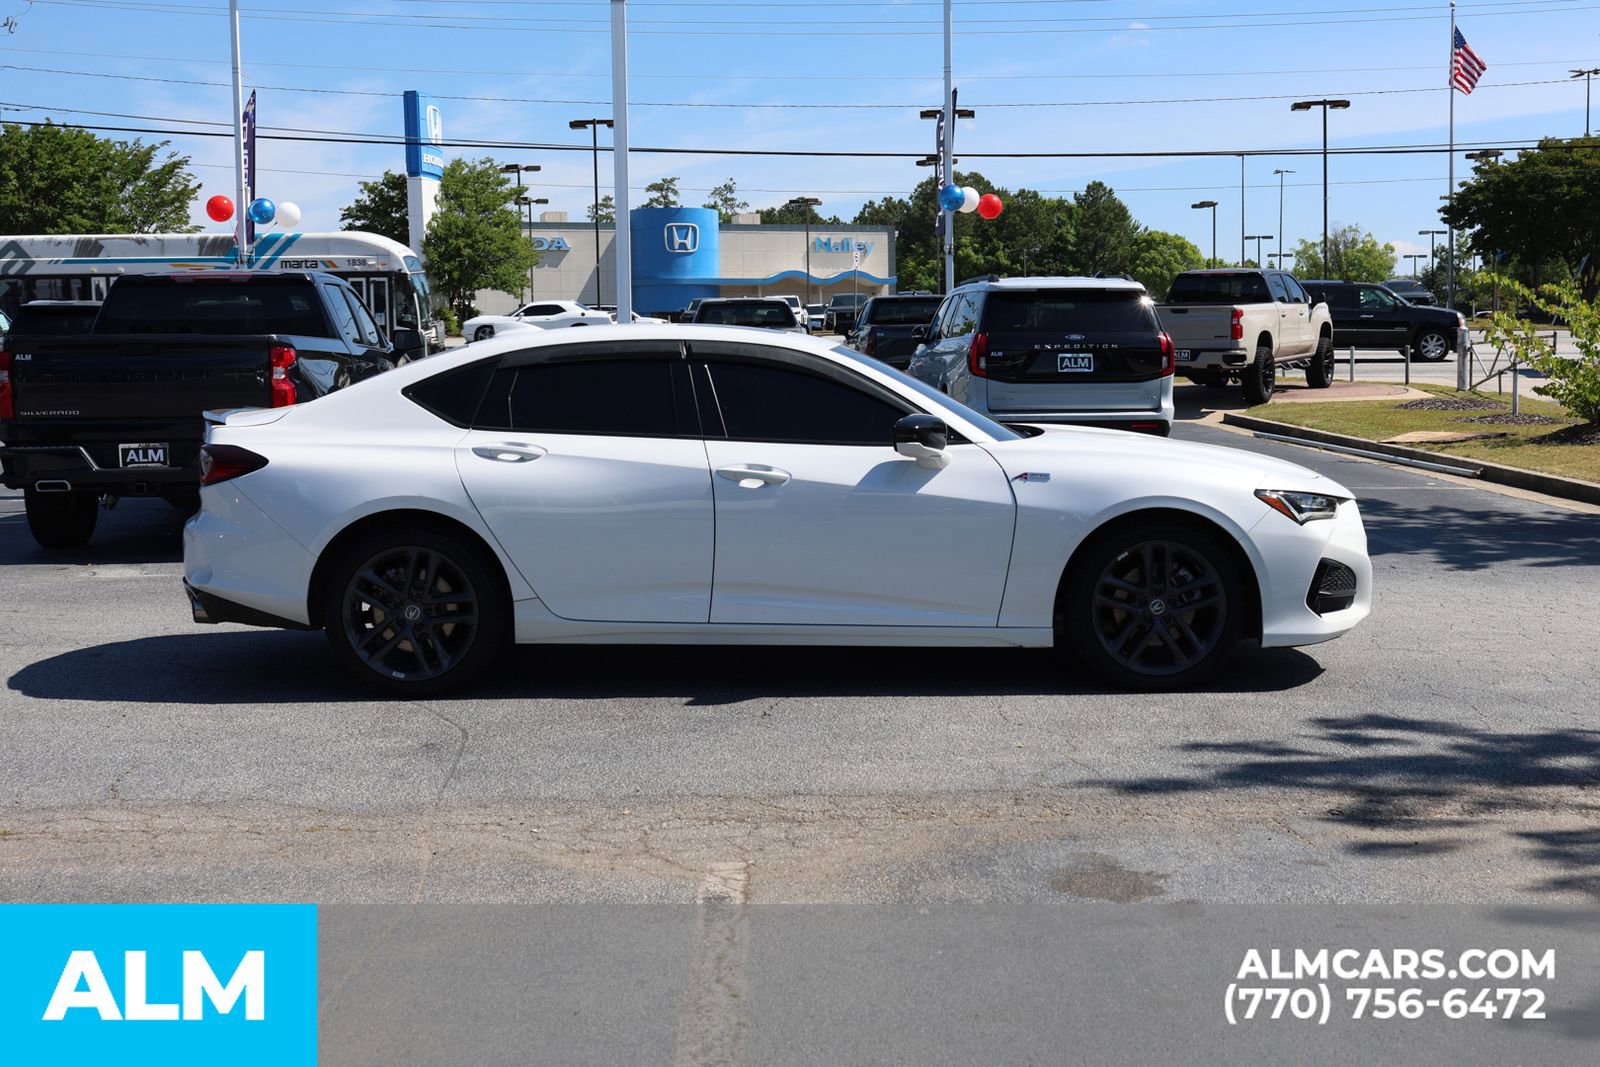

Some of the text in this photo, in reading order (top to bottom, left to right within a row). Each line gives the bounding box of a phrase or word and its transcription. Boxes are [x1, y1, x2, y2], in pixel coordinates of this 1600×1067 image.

[815, 236, 875, 256] Nalley
[280, 260, 318, 269] marta
[15, 353, 32, 361] ALM
[1062, 358, 1089, 368] ALM
[126, 449, 164, 462] ALM
